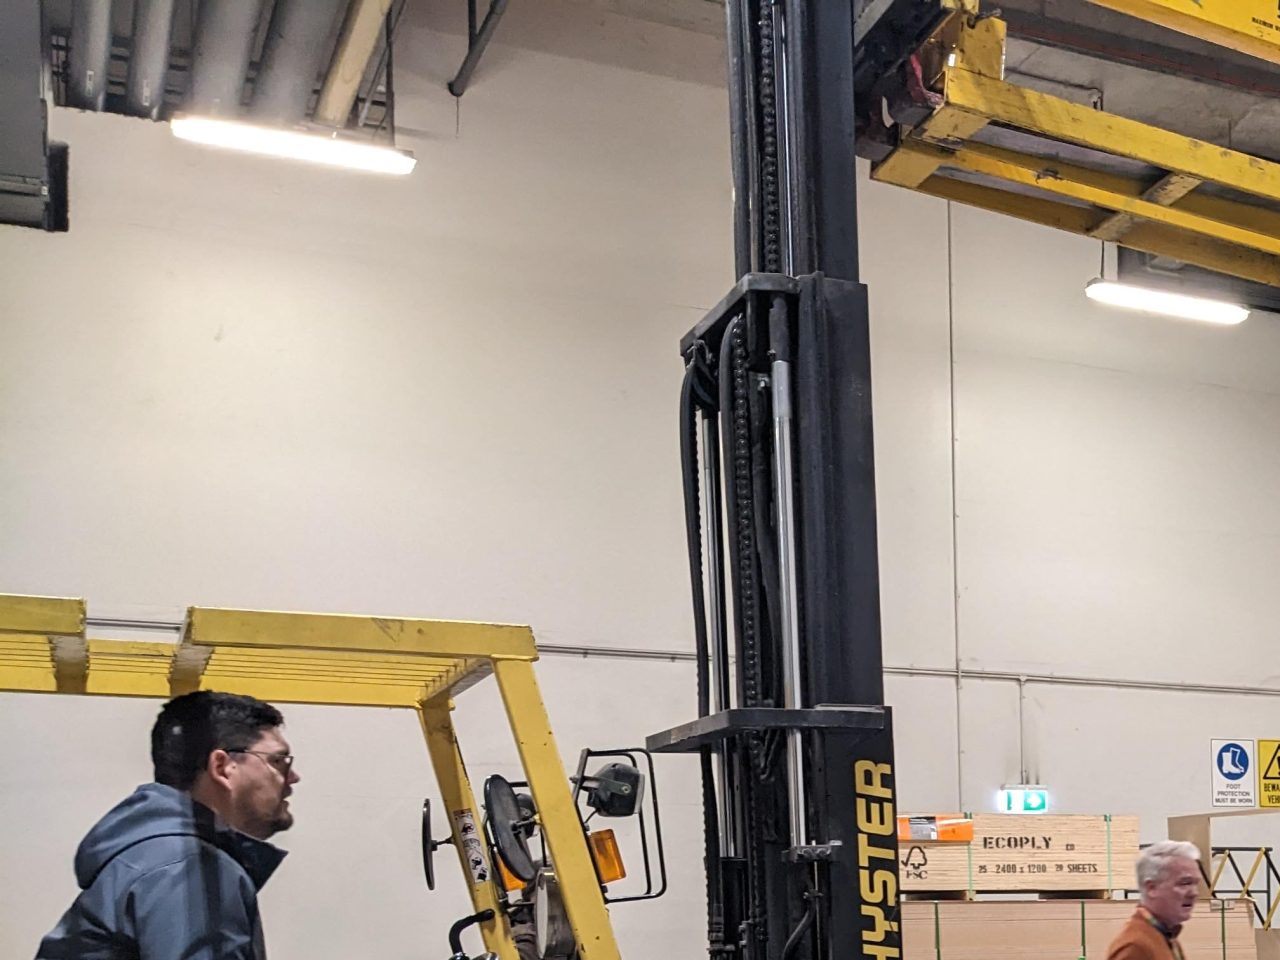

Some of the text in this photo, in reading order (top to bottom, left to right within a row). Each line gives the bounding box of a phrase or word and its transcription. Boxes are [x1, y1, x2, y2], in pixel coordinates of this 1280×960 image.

[983, 836, 1052, 850] ECOPLY
[995, 863, 1018, 874] 2400
[1027, 864, 1047, 873] 1200
[1067, 863, 1098, 873] SHEETS
[906, 870, 928, 880] FSC
